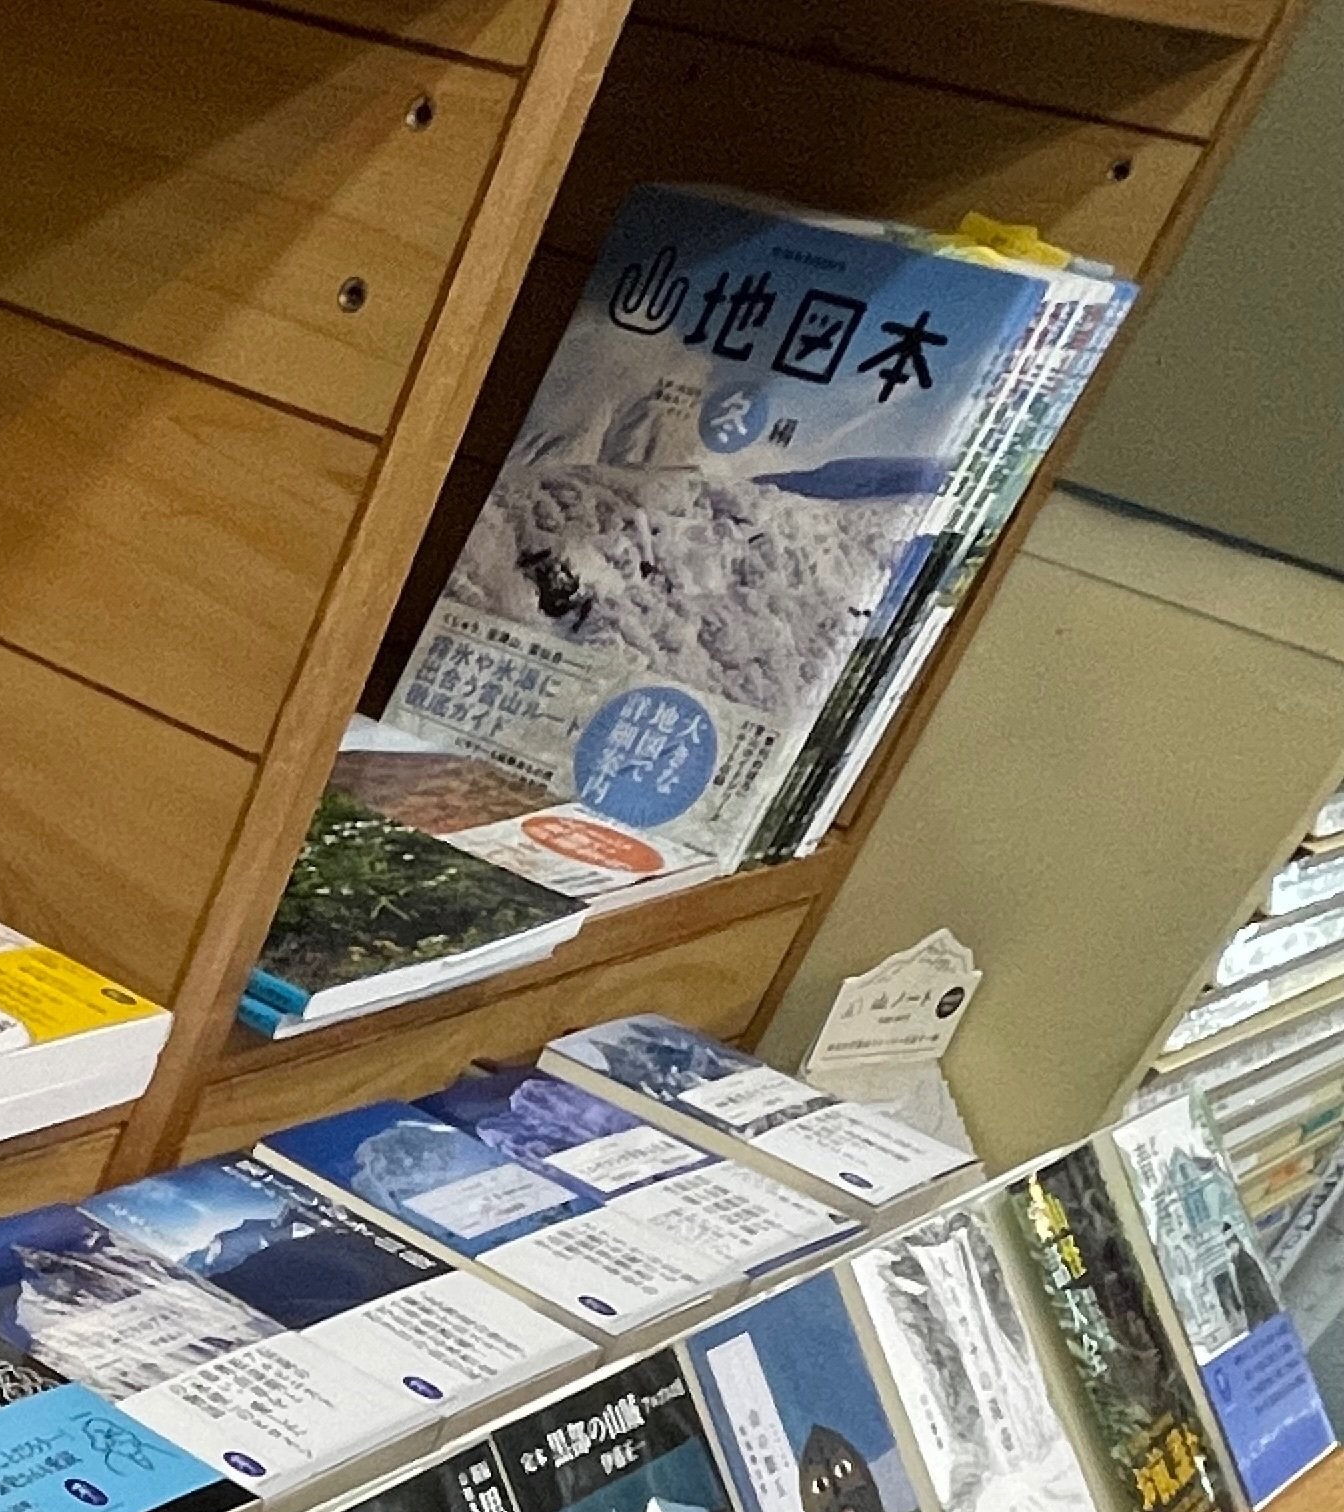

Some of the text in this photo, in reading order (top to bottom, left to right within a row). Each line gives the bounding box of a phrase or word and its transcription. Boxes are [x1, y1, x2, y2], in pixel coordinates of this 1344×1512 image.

[711, 391, 751, 443] 冬
[630, 699, 680, 783] 地図で
